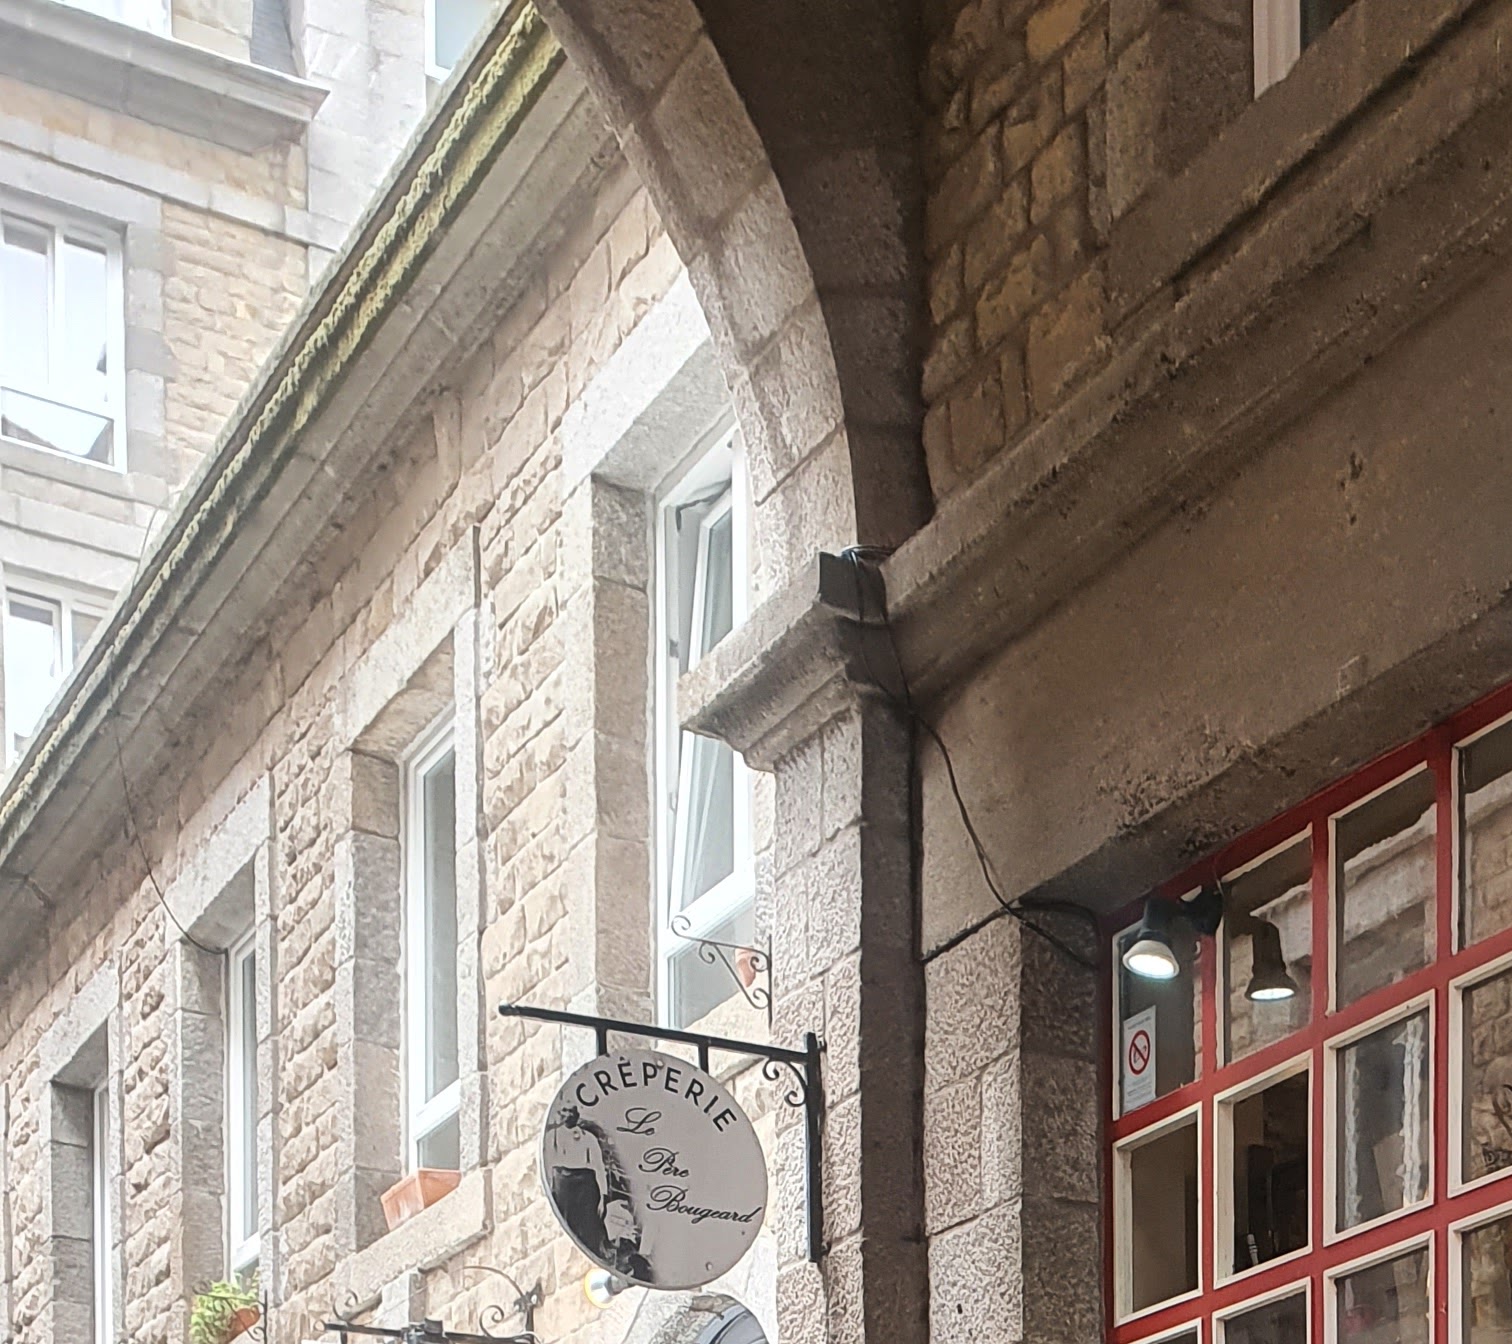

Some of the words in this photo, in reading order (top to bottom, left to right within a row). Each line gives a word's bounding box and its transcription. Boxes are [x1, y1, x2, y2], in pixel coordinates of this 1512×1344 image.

[576, 1056, 737, 1132] CRÊPERIE
[616, 1107, 662, 1136] Le
[638, 1147, 690, 1178] Père
[646, 1185, 763, 1224] Bougeard
